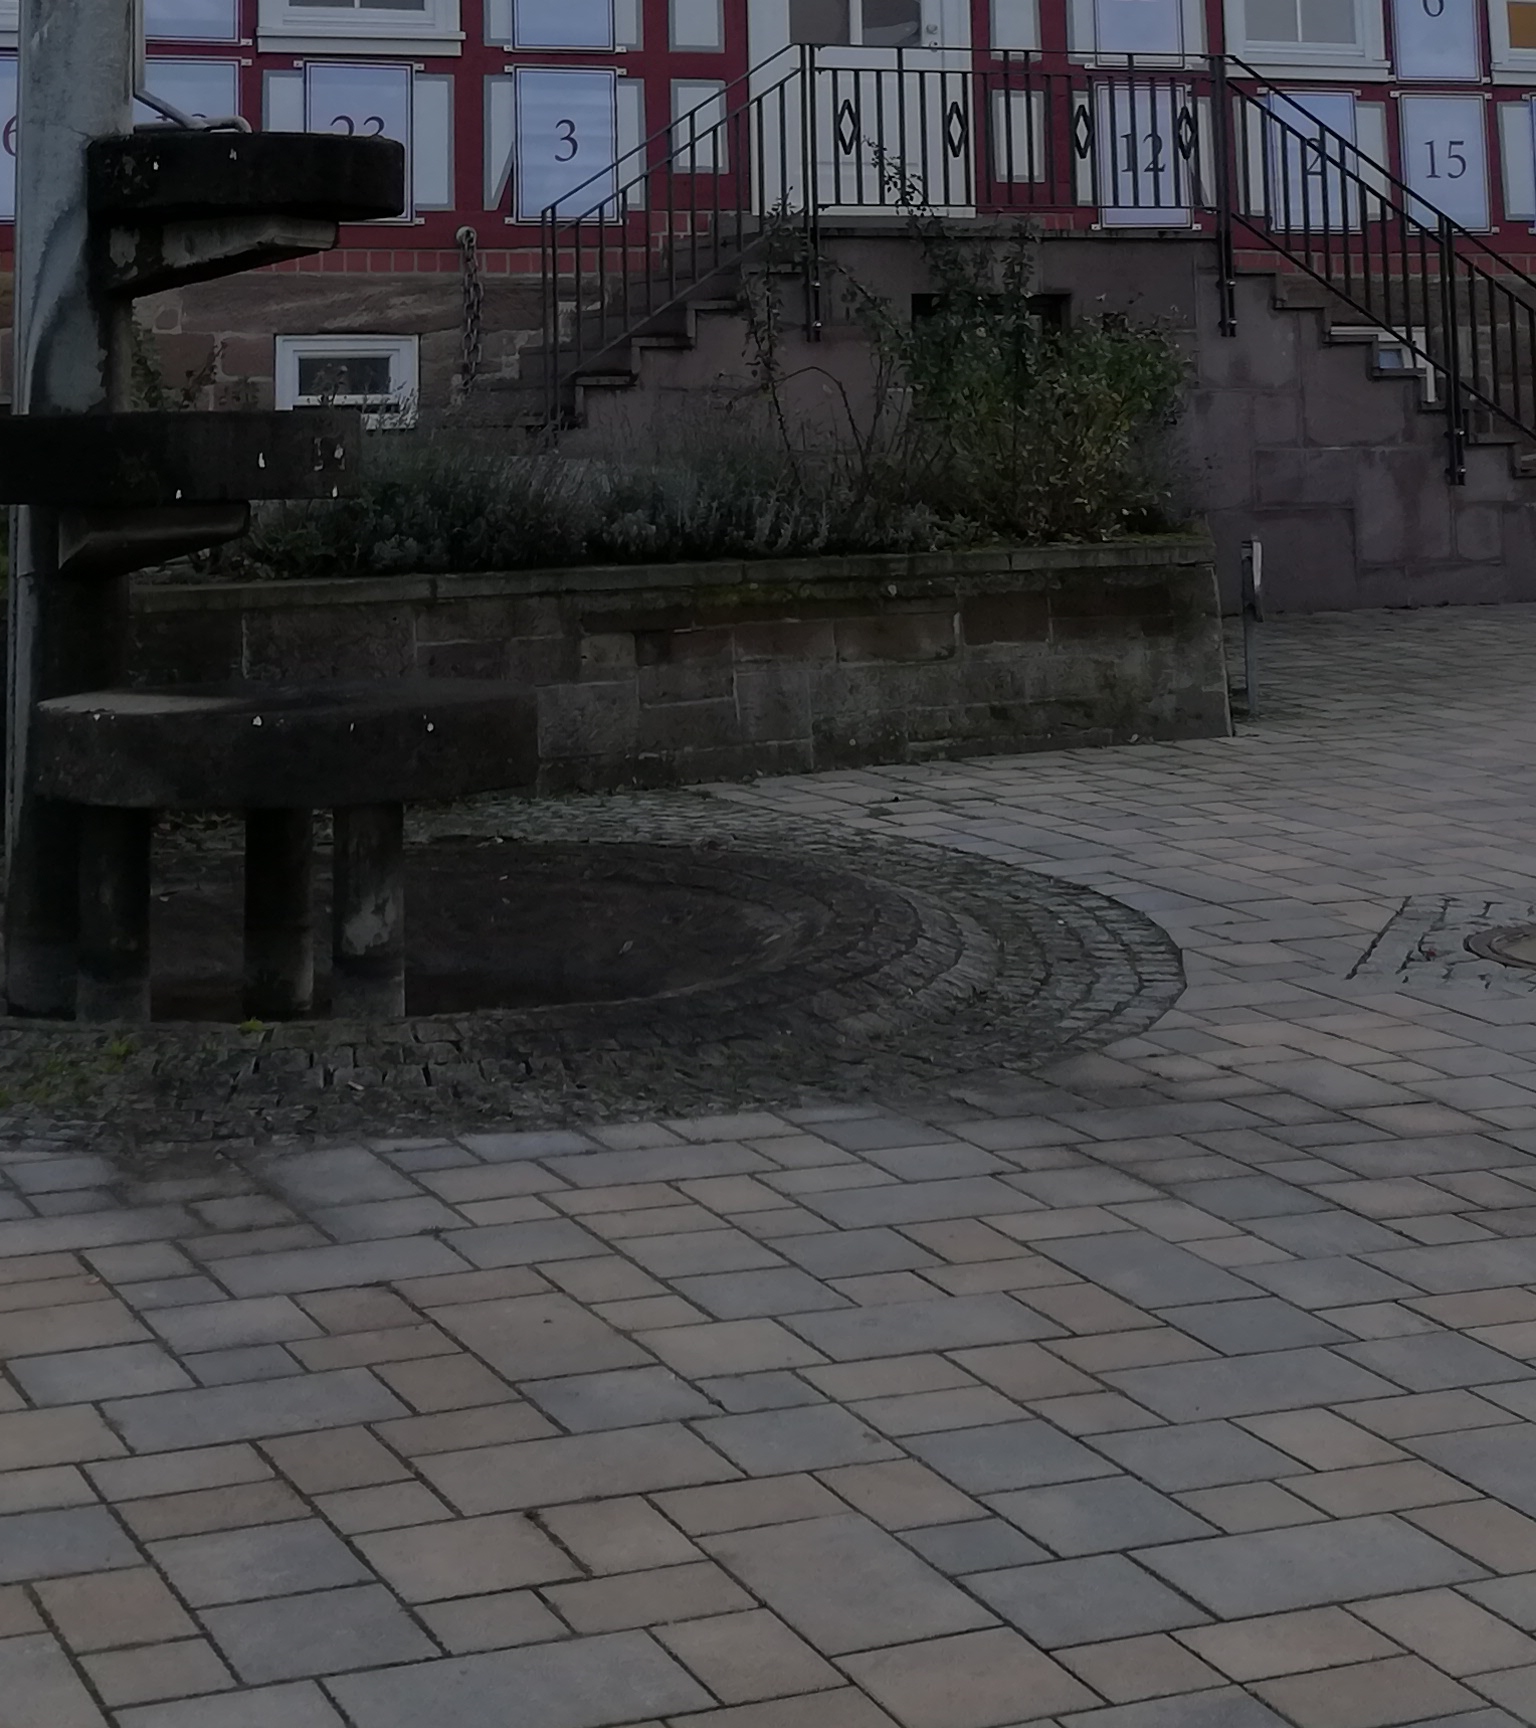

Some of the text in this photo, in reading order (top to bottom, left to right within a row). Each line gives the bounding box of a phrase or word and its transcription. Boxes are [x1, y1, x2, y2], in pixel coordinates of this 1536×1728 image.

[553, 119, 579, 162] 3
[1120, 133, 1166, 173] 12
[1423, 139, 1468, 179] 15
